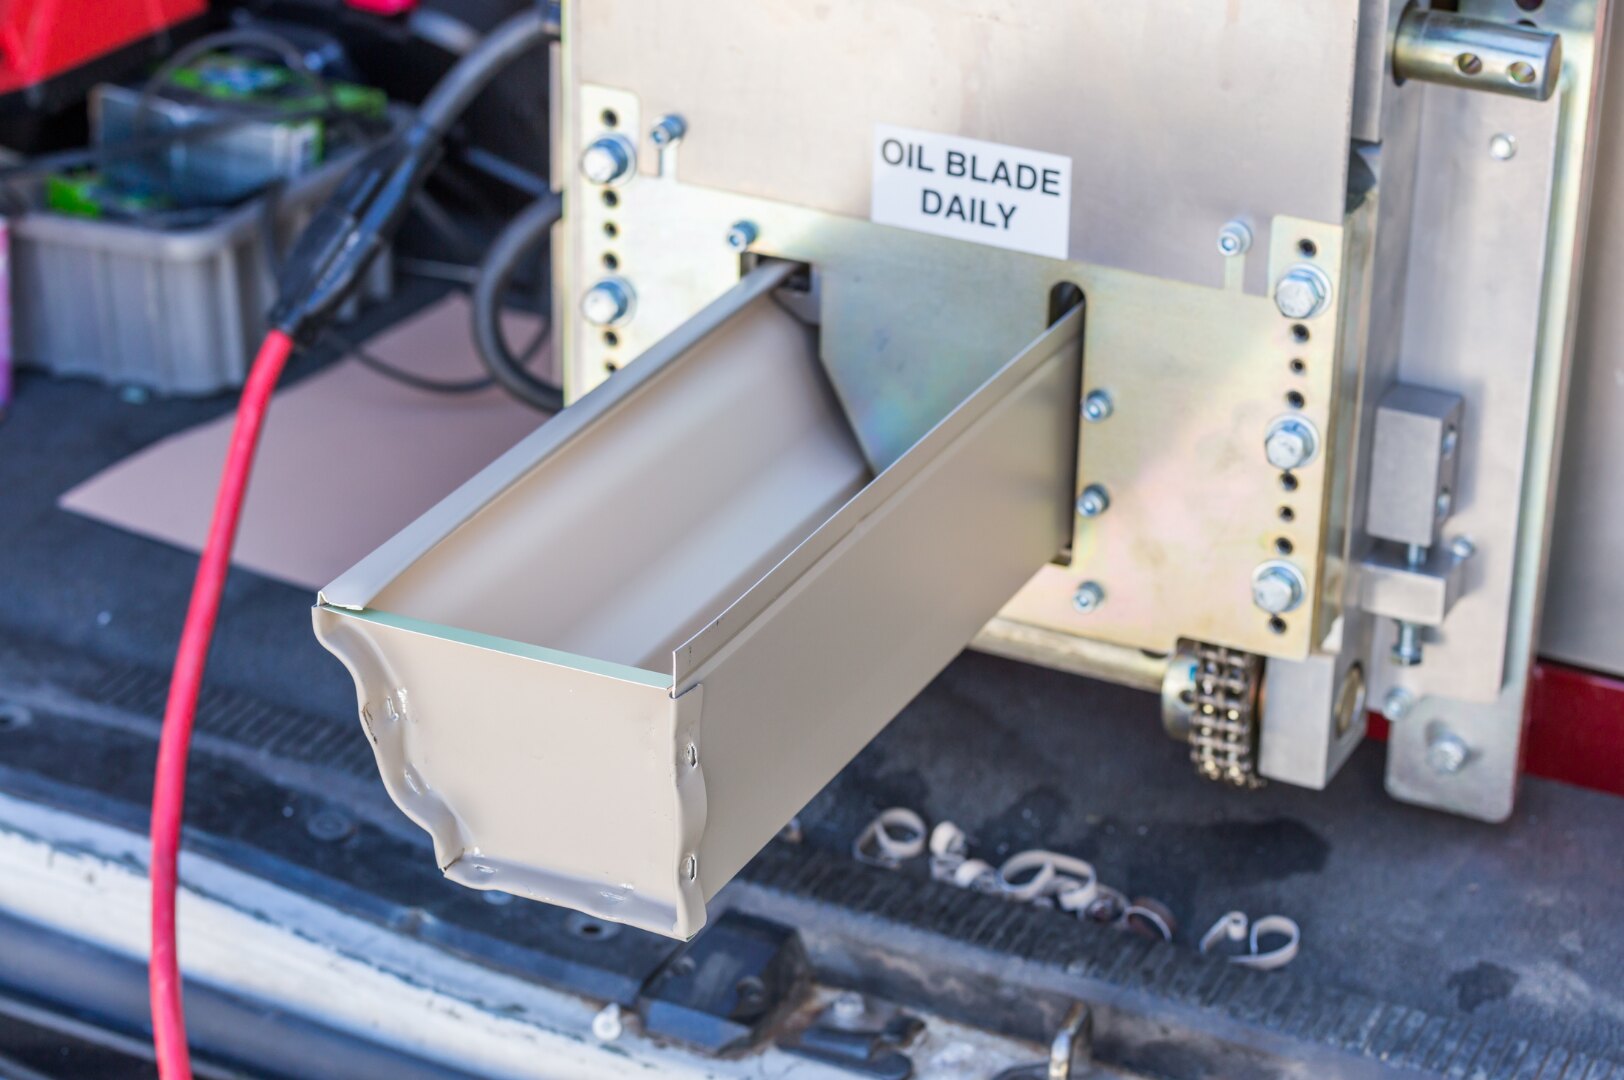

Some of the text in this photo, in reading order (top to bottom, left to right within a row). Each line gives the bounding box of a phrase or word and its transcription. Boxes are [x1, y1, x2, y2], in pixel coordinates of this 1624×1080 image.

[881, 138, 1060, 196] OIL BLADE
[921, 188, 1017, 229] DAILY
